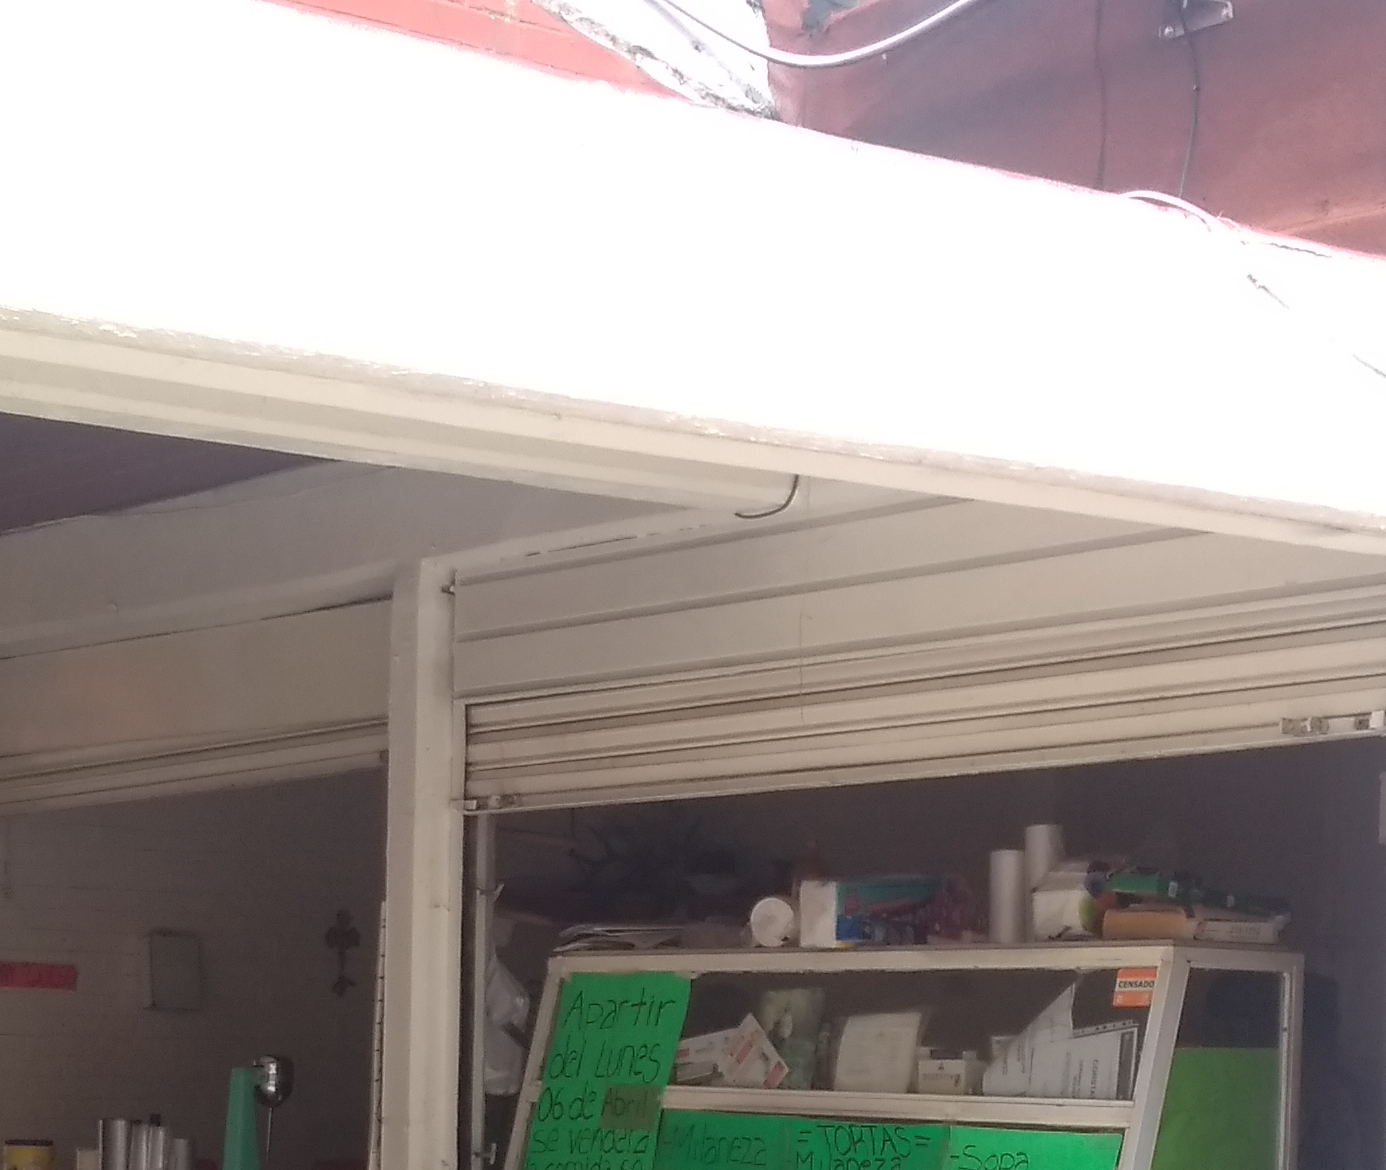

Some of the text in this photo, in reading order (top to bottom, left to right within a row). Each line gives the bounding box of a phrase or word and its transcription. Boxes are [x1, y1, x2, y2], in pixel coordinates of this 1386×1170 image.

[1118, 980, 1155, 989] CENSADO
[549, 1034, 586, 1079] del
[538, 1080, 649, 1121] 06 de Abril
[530, 1129, 559, 1153] se
